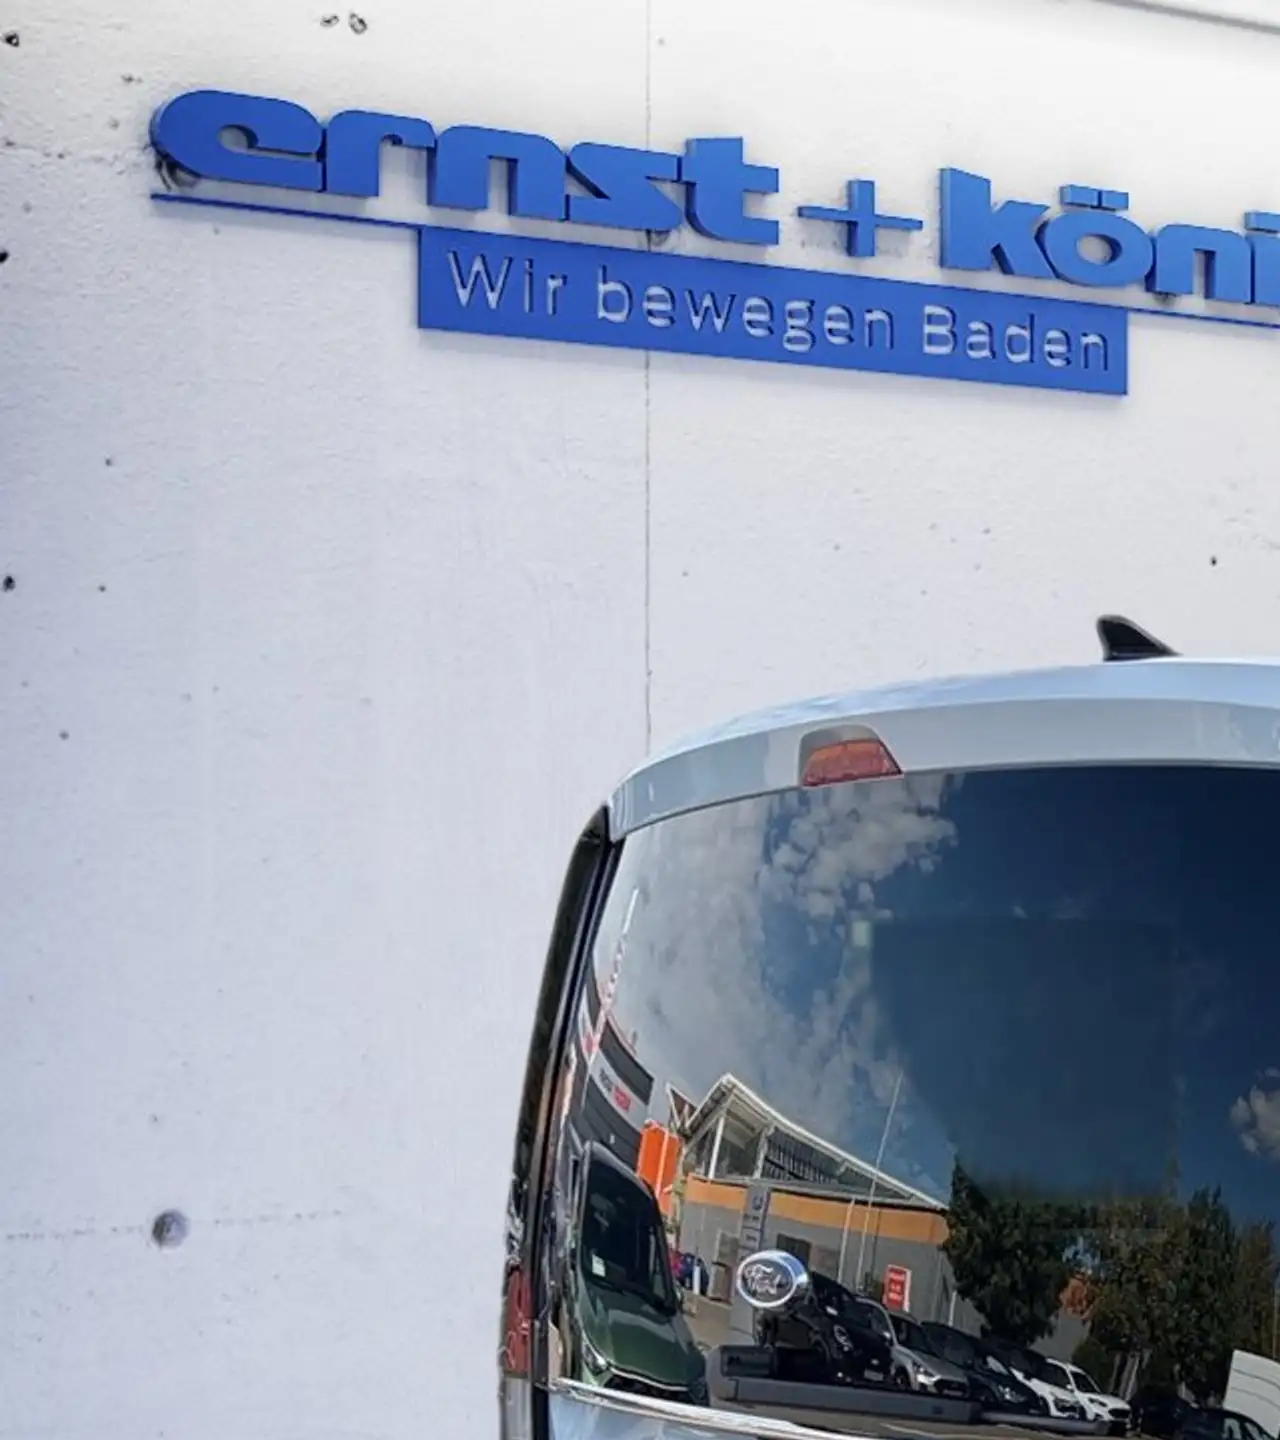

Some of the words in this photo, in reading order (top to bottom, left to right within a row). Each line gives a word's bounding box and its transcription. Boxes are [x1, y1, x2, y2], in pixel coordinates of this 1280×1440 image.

[446, 250, 568, 315] Wir
[596, 266, 895, 355] bewegen
[921, 304, 1110, 372] Baden
